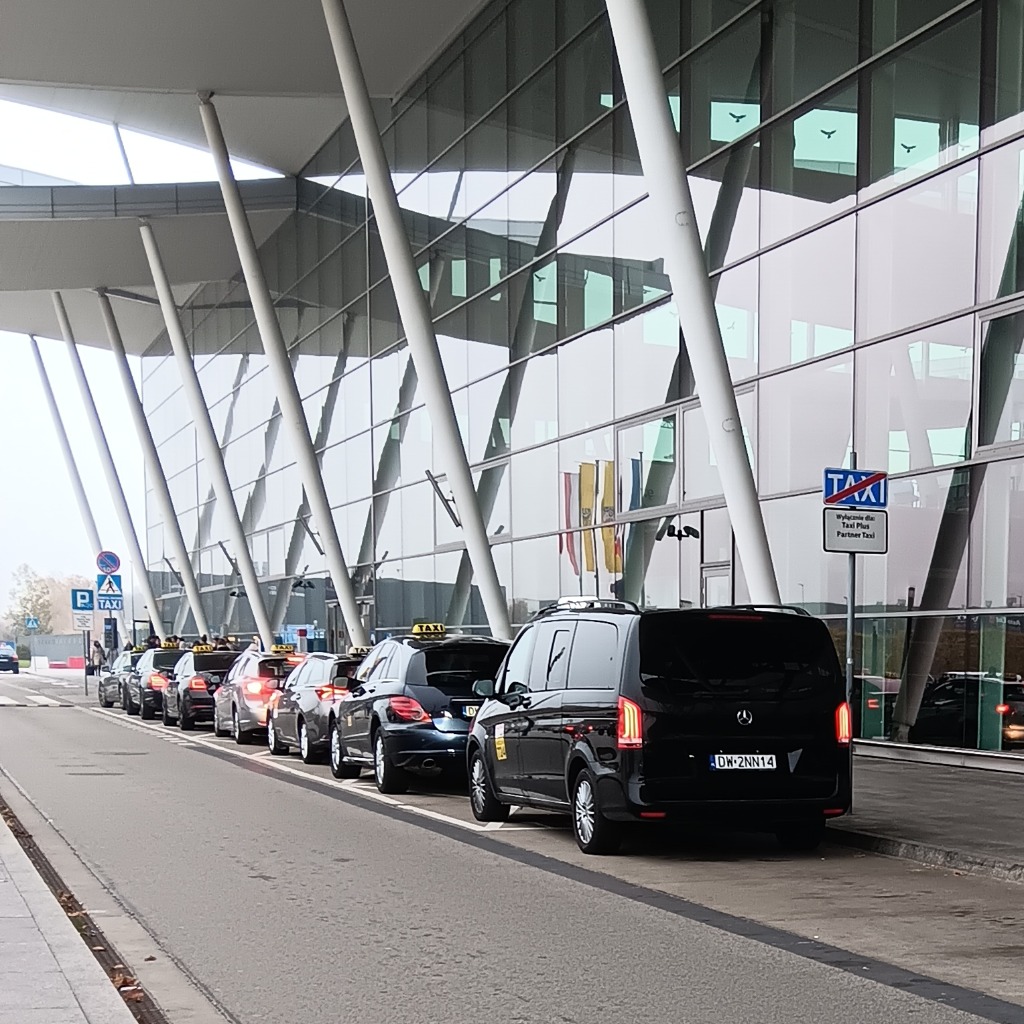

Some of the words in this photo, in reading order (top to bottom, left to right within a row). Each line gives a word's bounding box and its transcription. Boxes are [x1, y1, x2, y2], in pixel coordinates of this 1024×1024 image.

[828, 473, 885, 503] TAXI
[856, 522, 870, 530] Plus
[76, 591, 90, 608] P
[98, 599, 121, 609] TAXI
[417, 624, 443, 632] TAXI
[718, 756, 733, 767] DW
[738, 756, 774, 768] 2NN14
